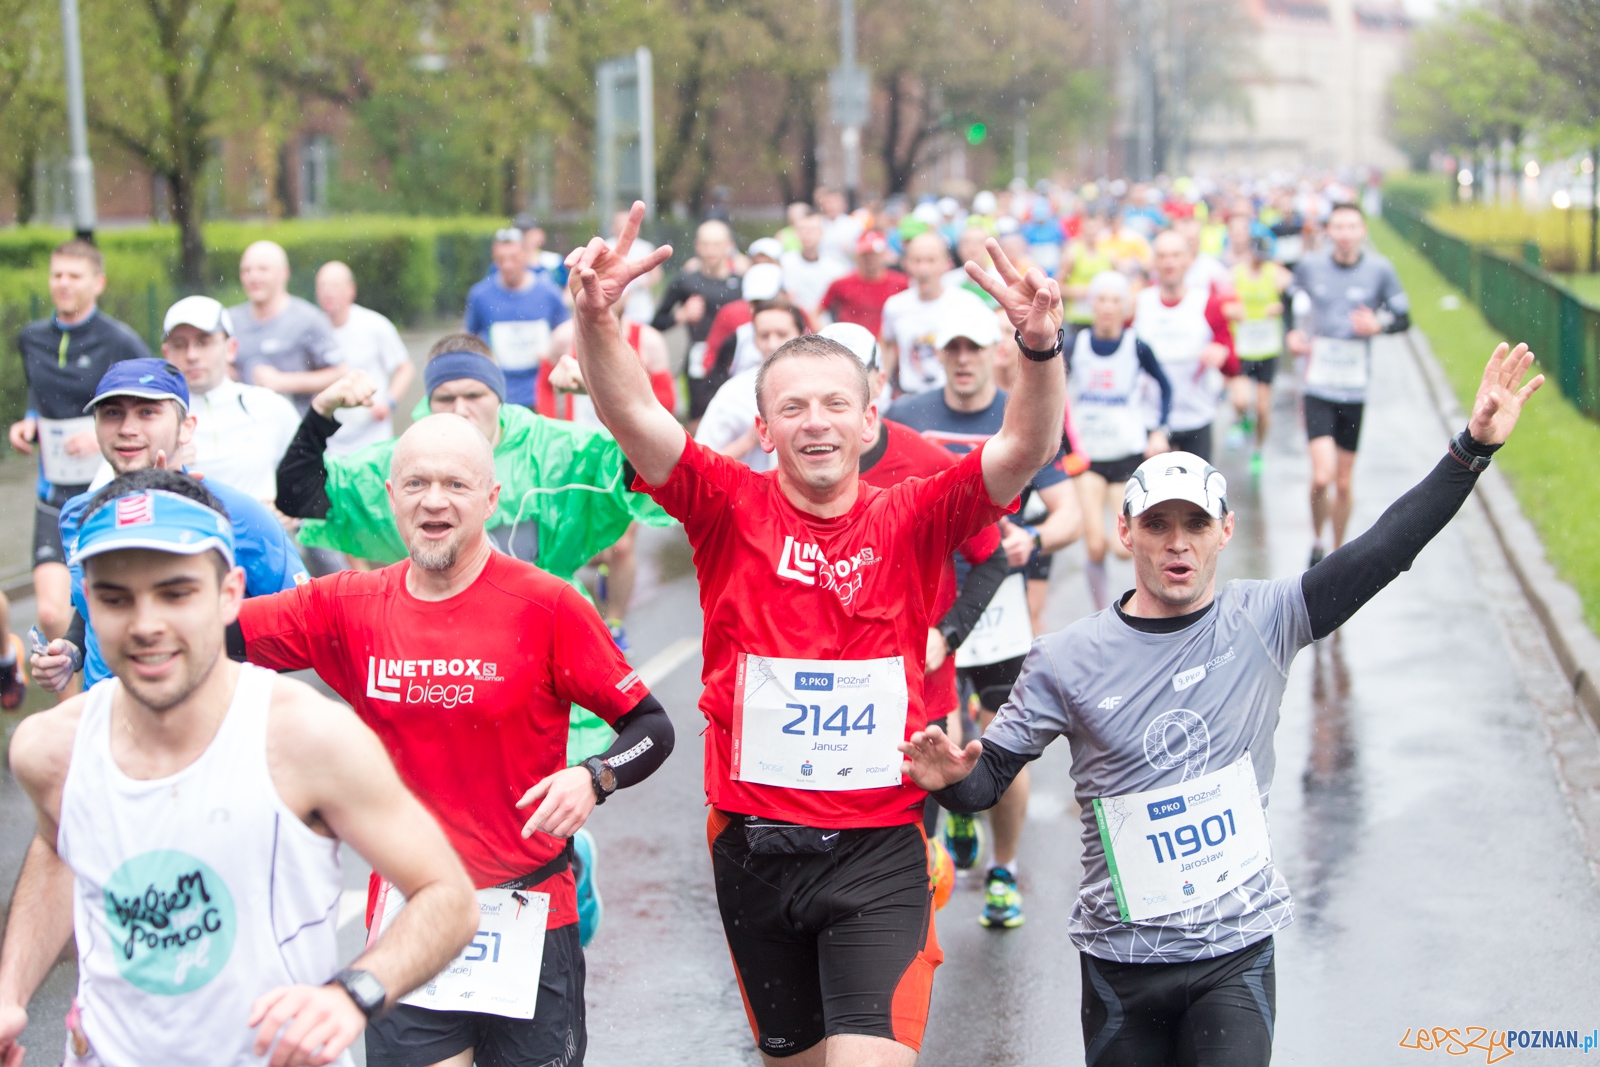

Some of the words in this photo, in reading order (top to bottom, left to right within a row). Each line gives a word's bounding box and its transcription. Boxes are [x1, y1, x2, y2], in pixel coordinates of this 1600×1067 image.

[387, 659, 481, 677] NETBOX
[406, 679, 475, 709] biega
[1097, 695, 1123, 710] 4F
[782, 703, 876, 736] 2144
[811, 742, 849, 751] Janusz
[837, 767, 853, 776] 4F
[1146, 808, 1237, 863] 11901
[1180, 850, 1224, 873] Jarosław
[1216, 870, 1229, 883] 4F
[463, 931, 502, 963] 51
